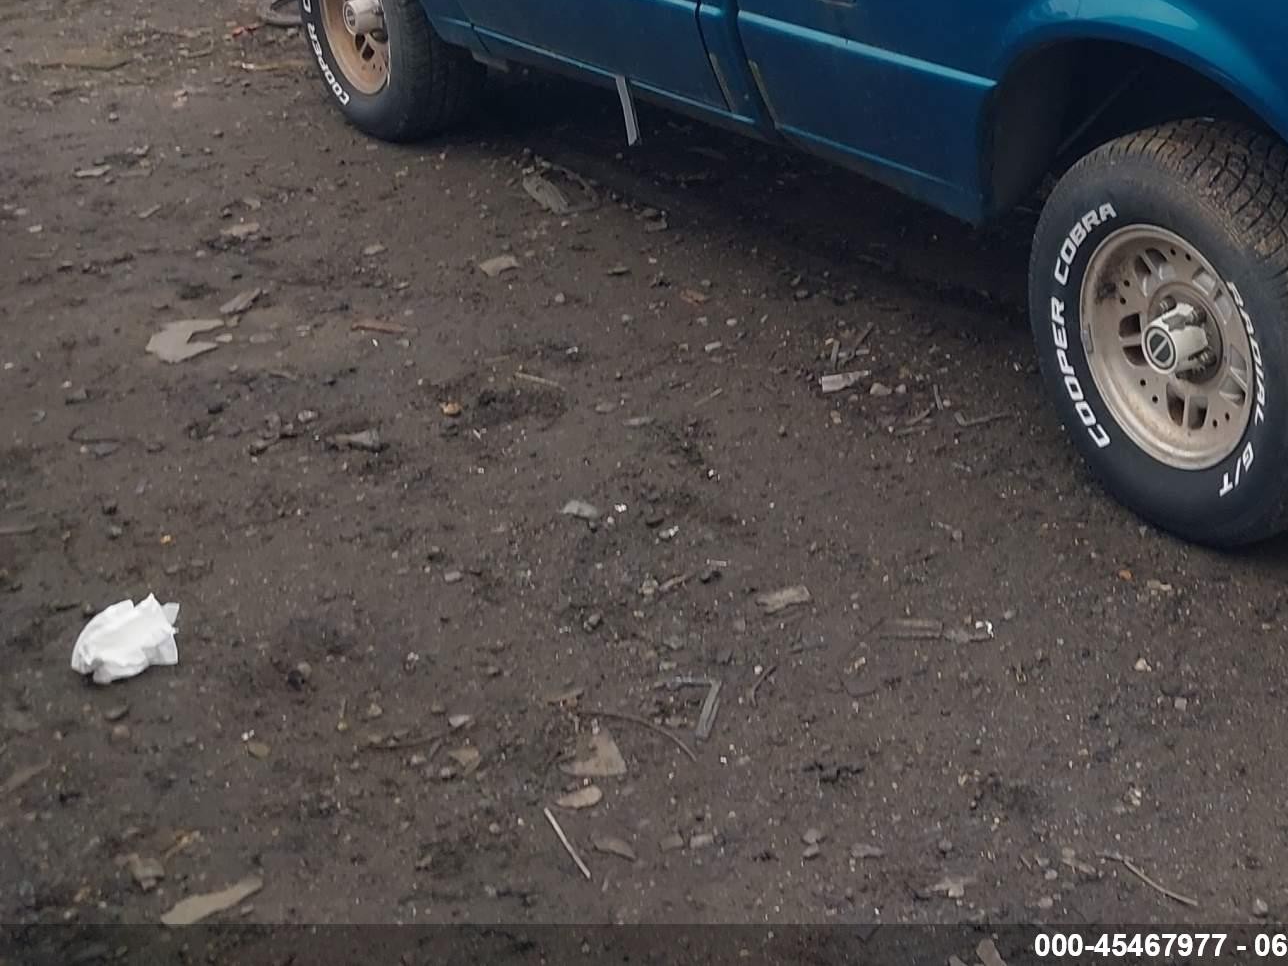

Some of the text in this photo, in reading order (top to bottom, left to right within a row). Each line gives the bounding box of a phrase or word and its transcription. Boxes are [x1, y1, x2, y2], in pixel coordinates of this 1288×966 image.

[307, 22, 350, 106] COOPER
[1051, 202, 1117, 448] COOPER COBRA
[1219, 281, 1266, 497] RADIAL G/T
